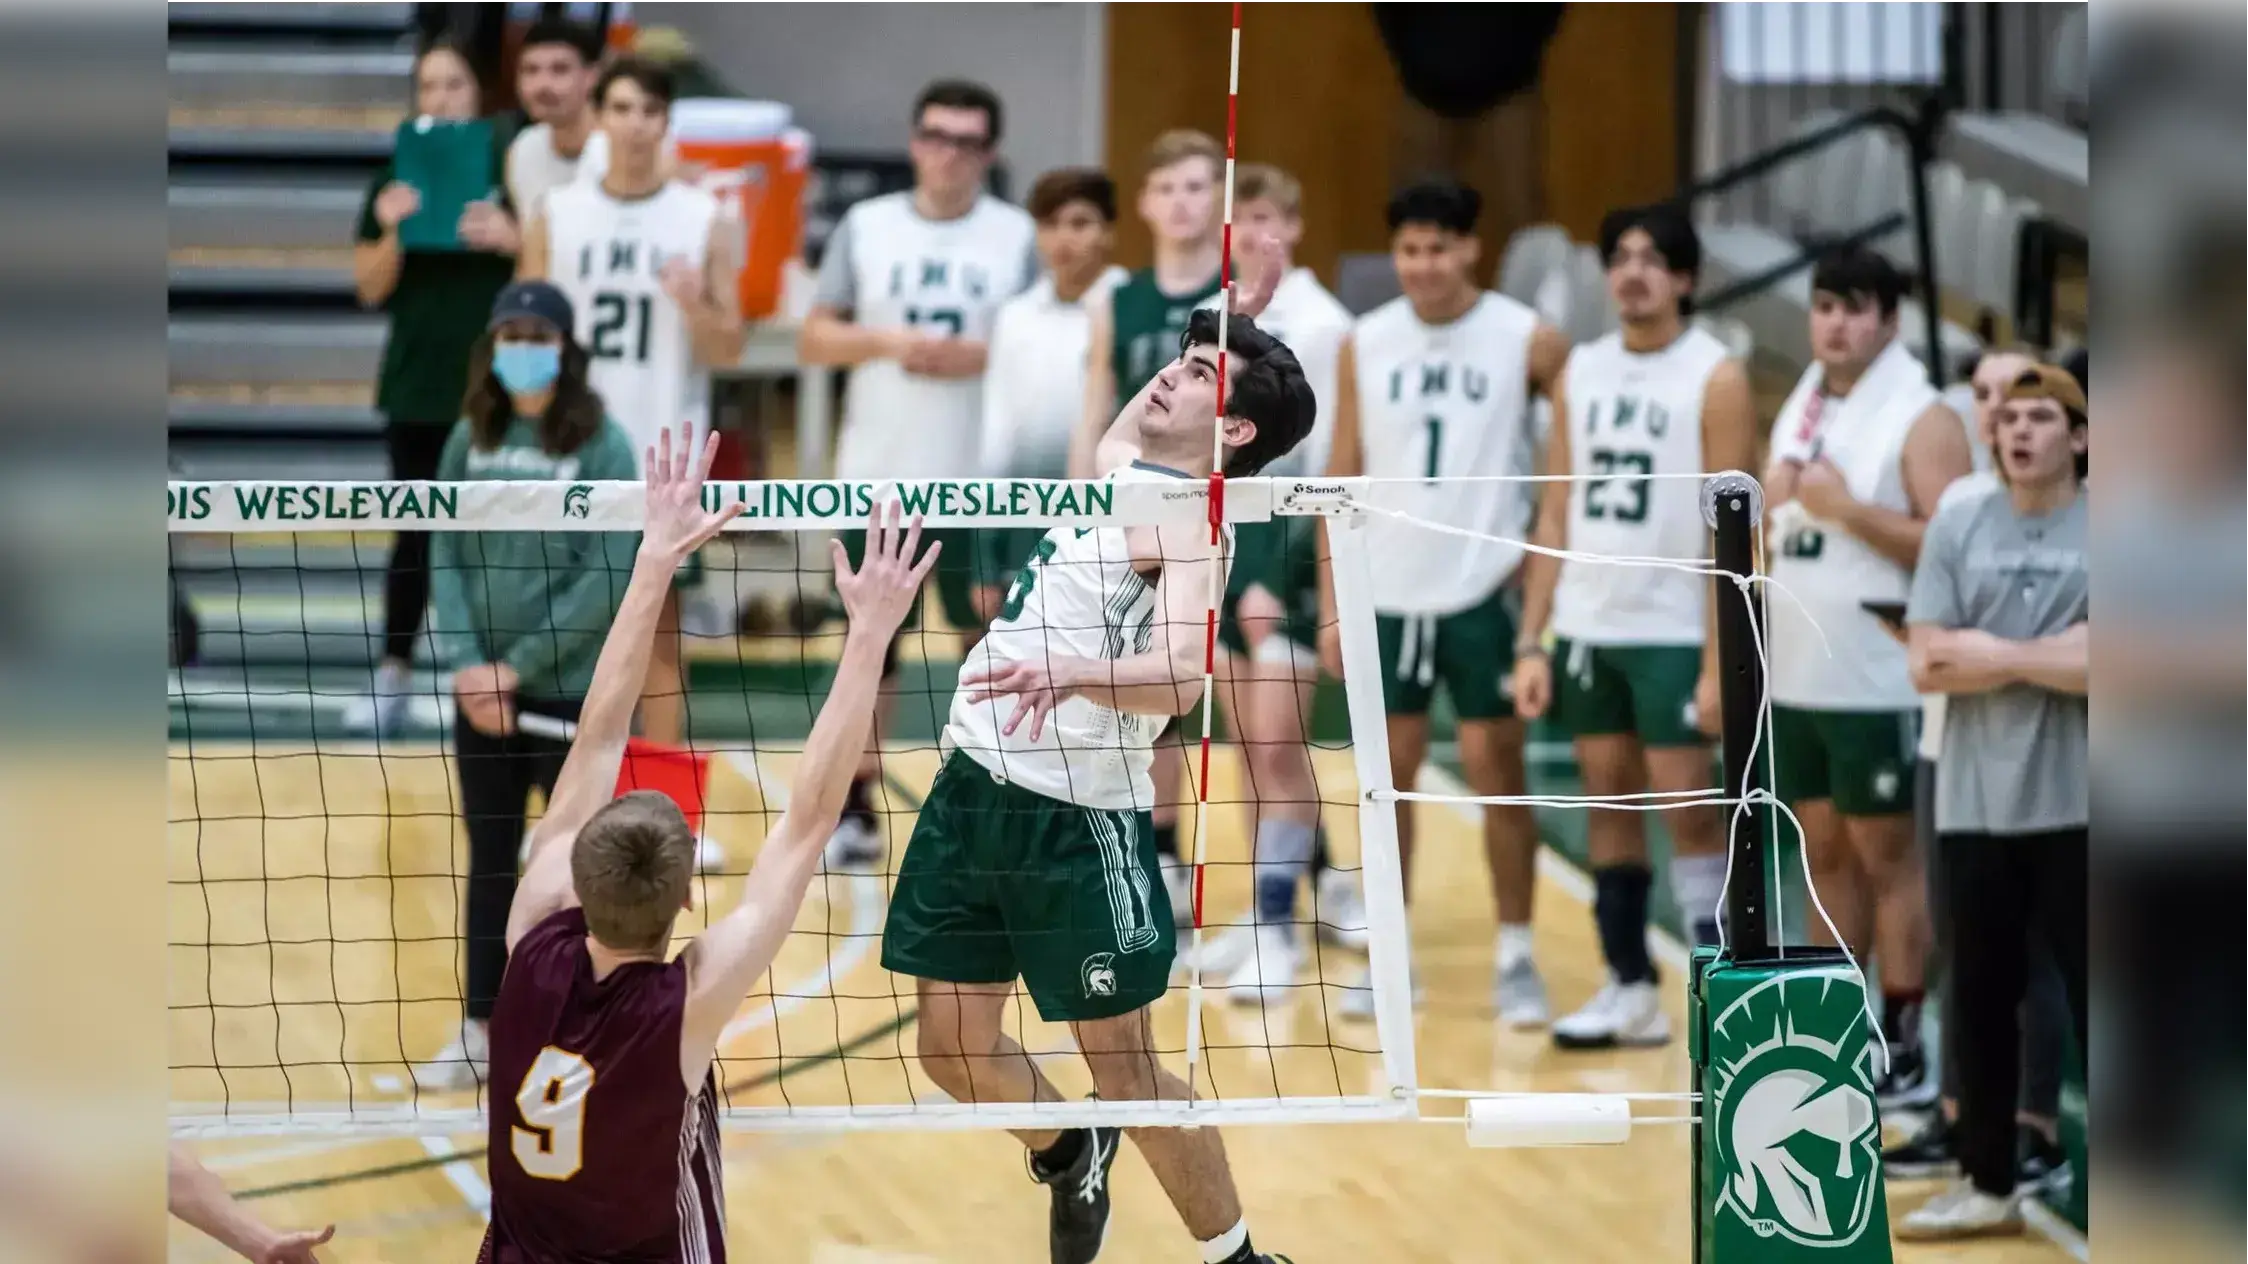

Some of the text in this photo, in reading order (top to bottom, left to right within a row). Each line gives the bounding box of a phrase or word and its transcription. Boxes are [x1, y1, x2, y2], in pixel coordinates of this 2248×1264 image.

[593, 291, 652, 362] 21
[1424, 414, 1442, 487] 1
[168, 486, 458, 520] IS WESLEYAN
[896, 482, 1113, 516] WESLEYAN
[1305, 485, 1345, 494] Senoh
[1585, 449, 1654, 523] 23
[511, 1044, 596, 1182] 9
[1757, 1222, 1775, 1232] TM
